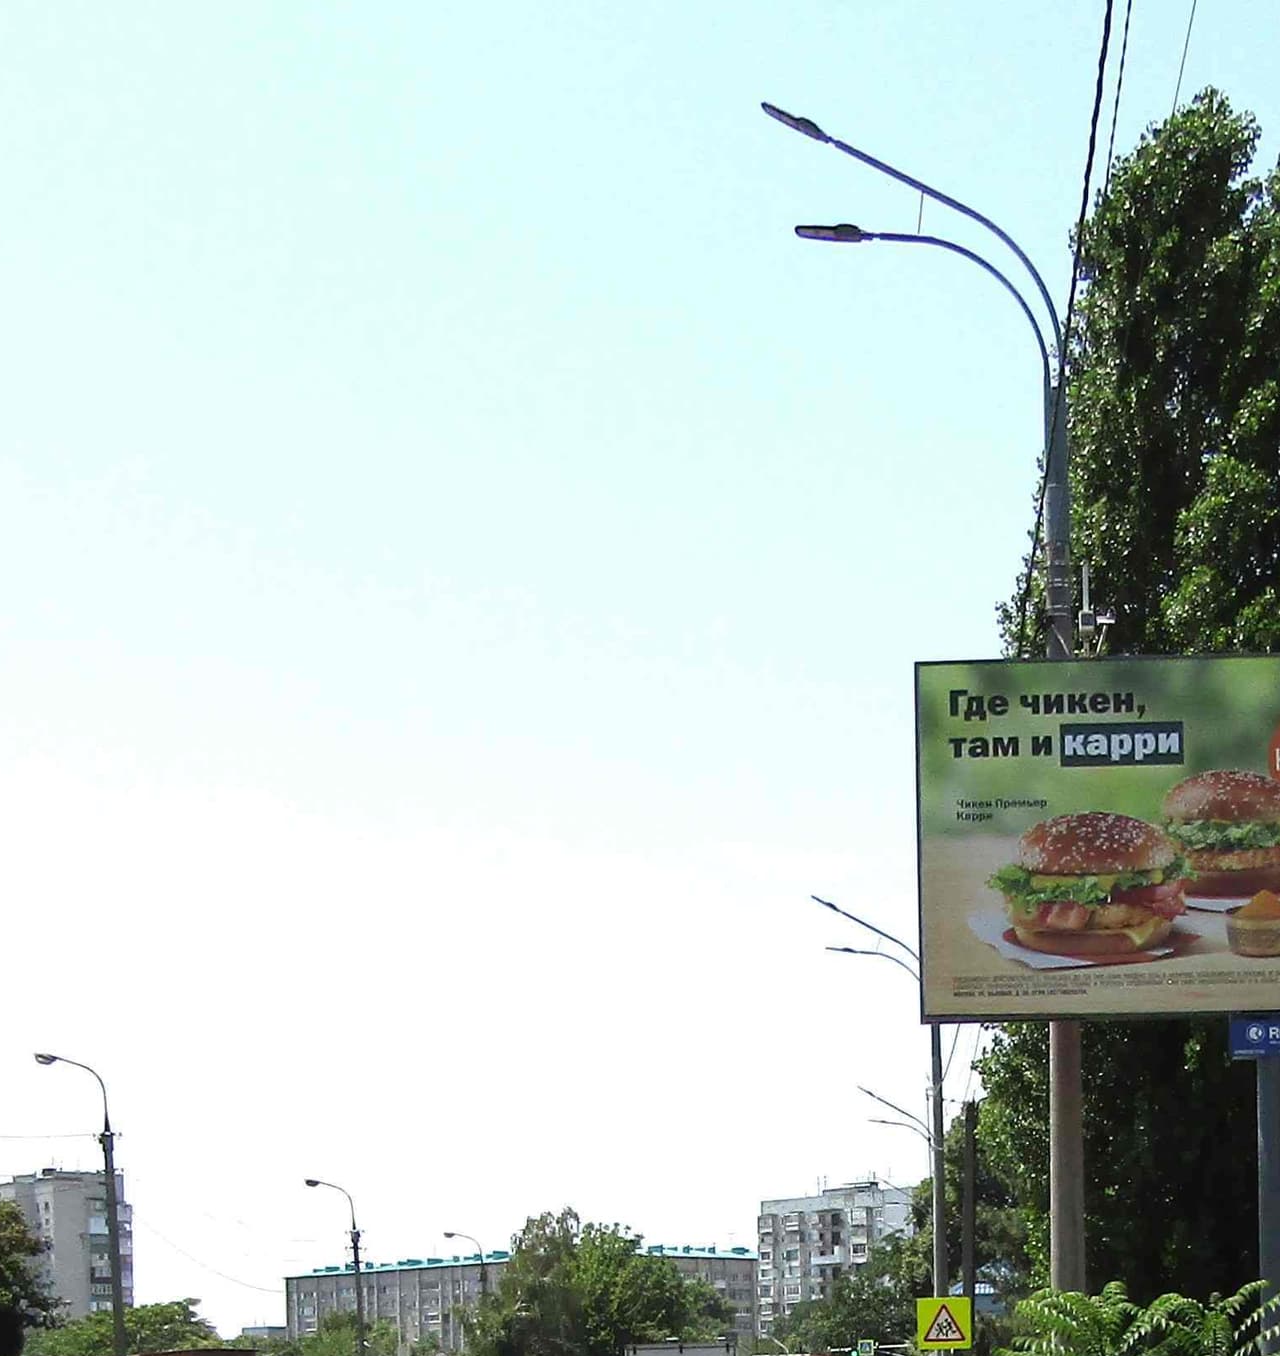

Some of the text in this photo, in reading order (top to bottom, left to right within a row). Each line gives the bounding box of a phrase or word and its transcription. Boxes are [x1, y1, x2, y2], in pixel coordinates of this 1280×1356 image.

[948, 689, 1147, 722] Где чикен,
[948, 730, 1180, 761] там и карри
[956, 798, 1048, 810] Чикен Премьер
[956, 811, 993, 823] Карри
